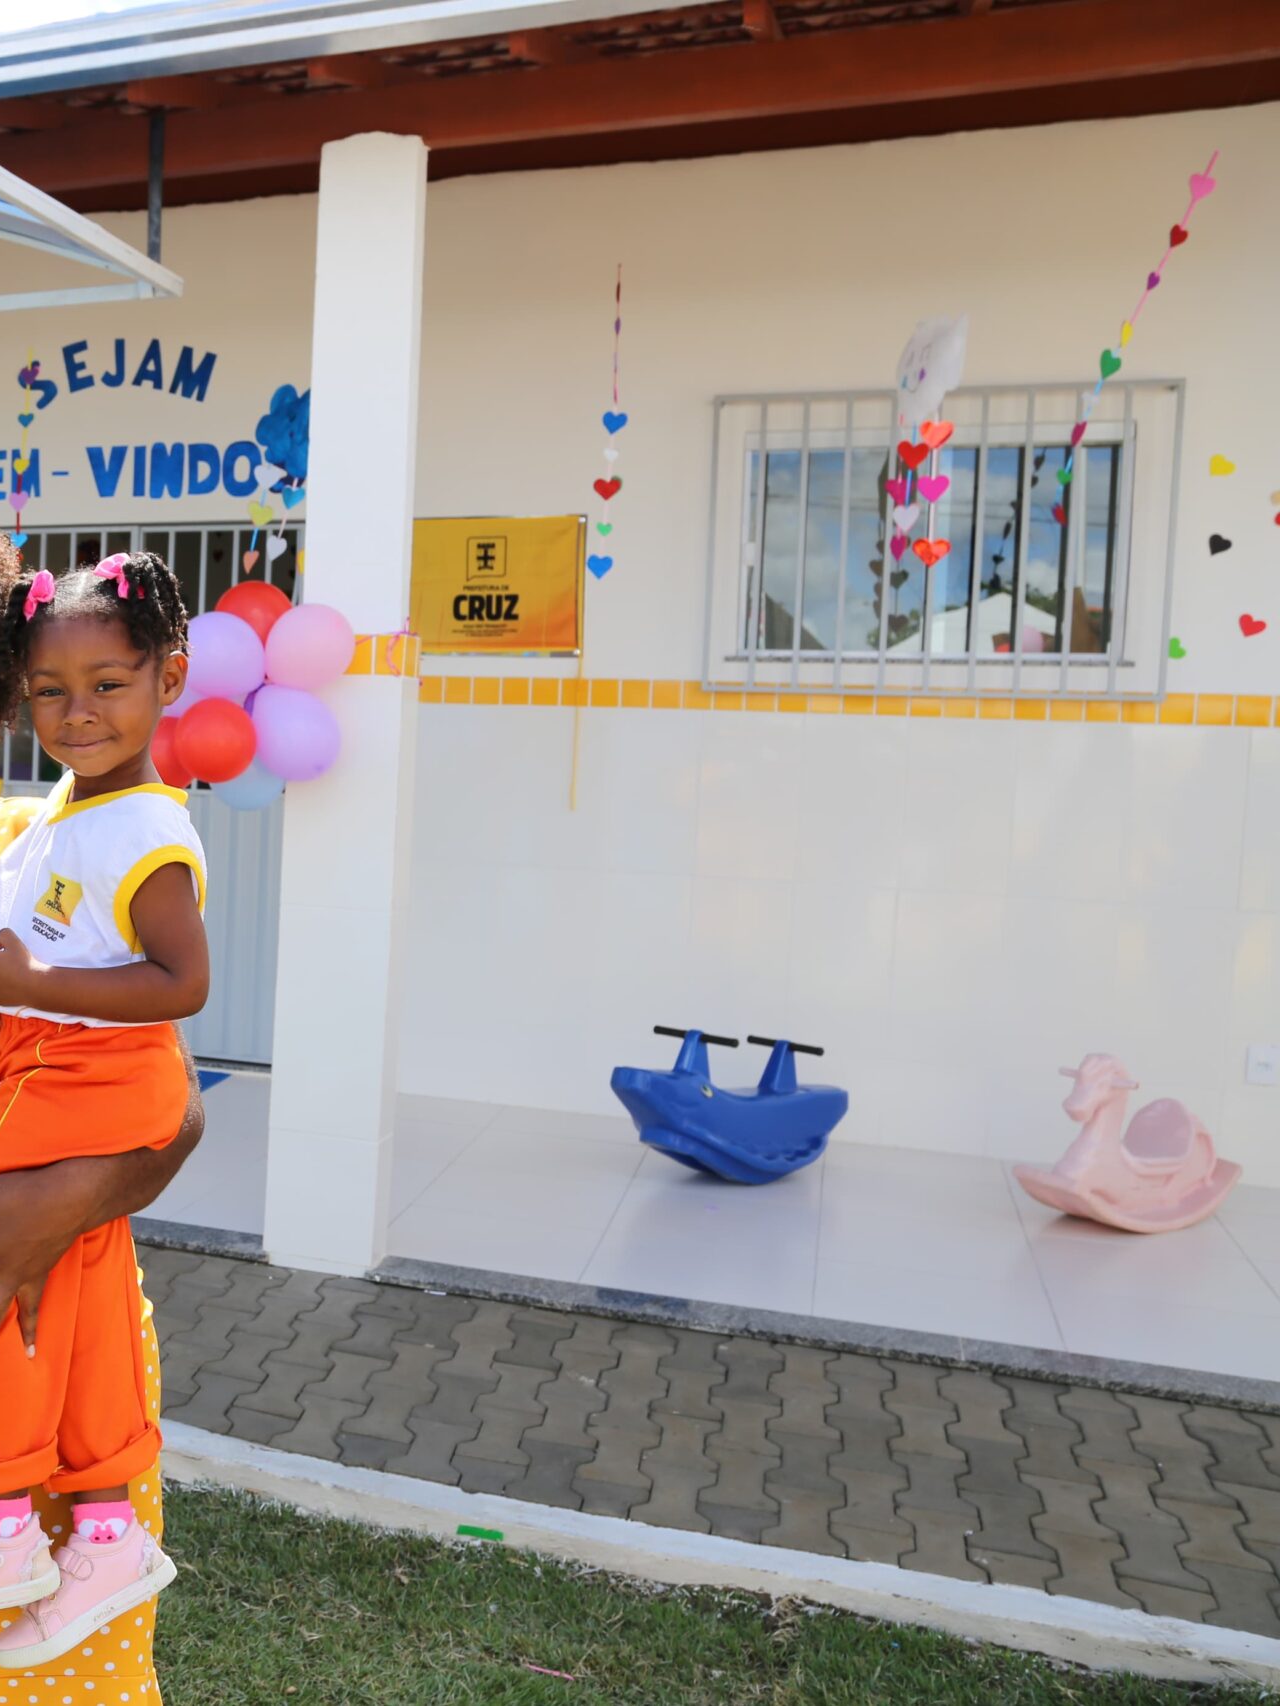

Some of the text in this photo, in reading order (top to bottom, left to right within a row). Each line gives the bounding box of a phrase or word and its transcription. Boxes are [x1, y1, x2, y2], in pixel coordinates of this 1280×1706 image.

[17, 338, 217, 410] SEJAM
[86, 441, 305, 498] VINDO
[453, 594, 519, 621] CRUZ
[32, 916, 59, 937] SECRETARIA
